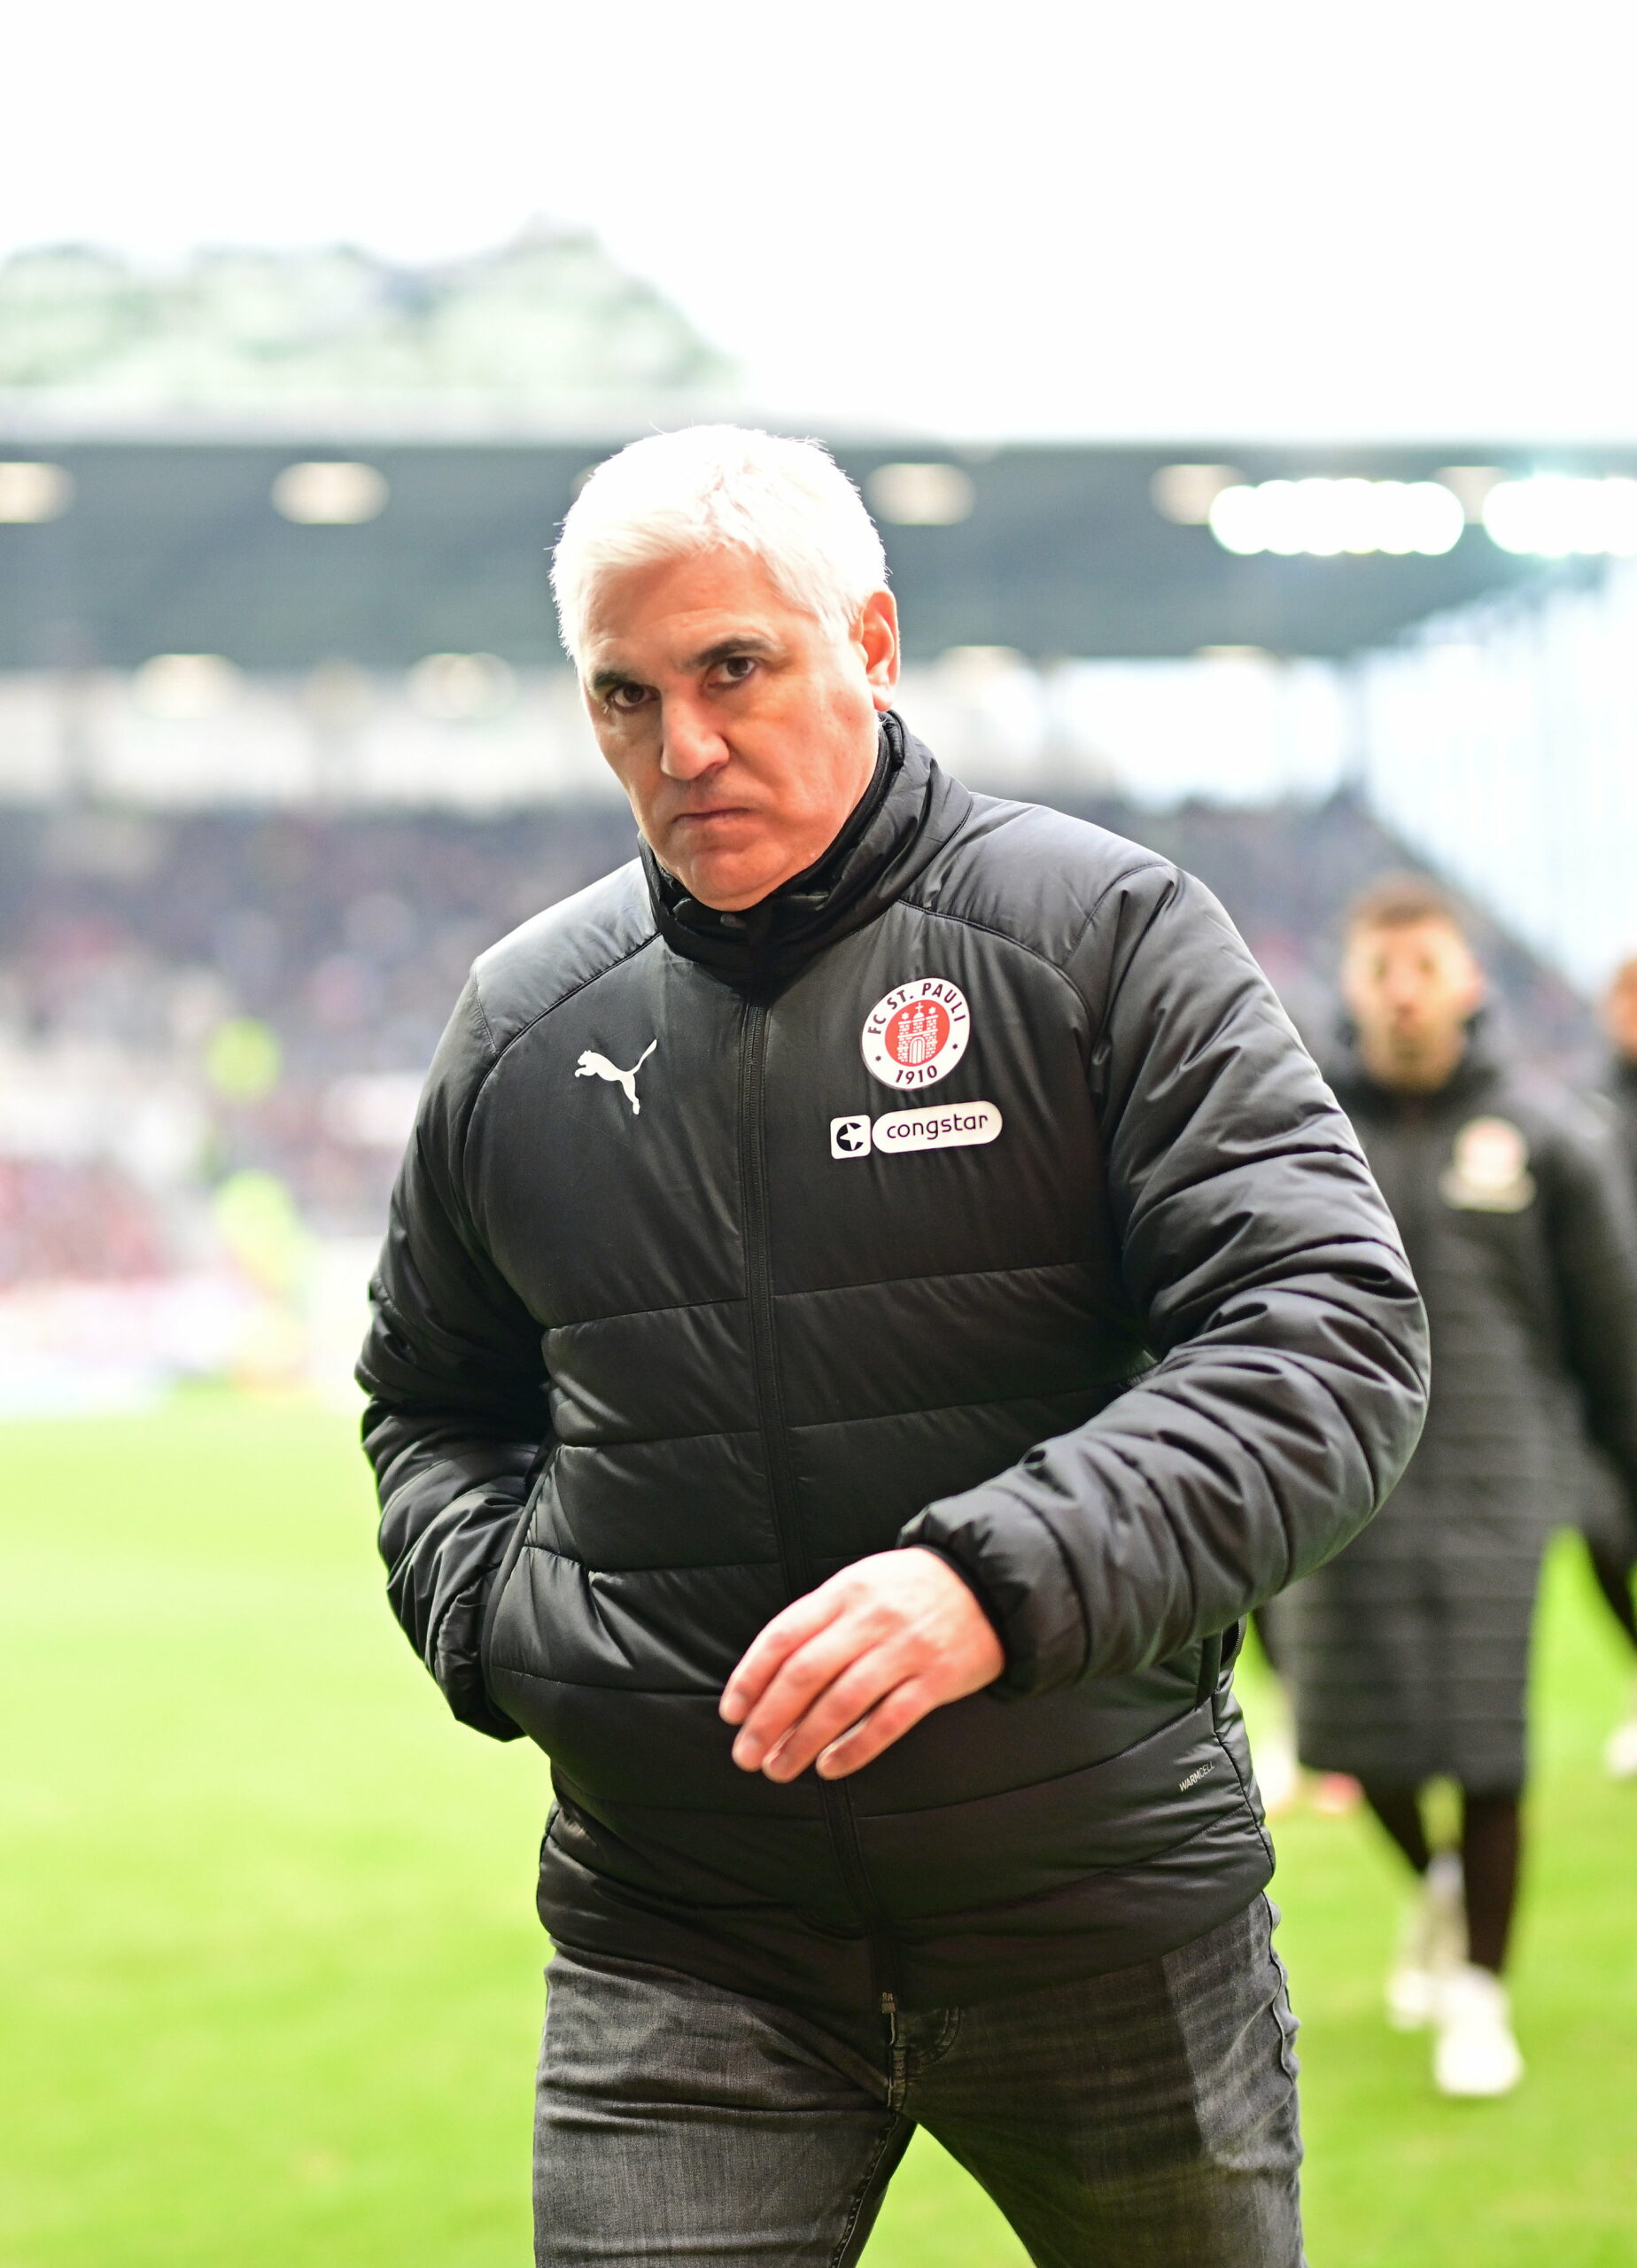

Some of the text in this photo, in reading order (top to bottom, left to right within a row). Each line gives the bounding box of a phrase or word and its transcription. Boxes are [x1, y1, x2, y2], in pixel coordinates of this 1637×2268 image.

[868, 983, 966, 1035] FC ST. PAULI
[896, 1065, 937, 1084] 1910
[887, 1114, 988, 1140] congstar
[1179, 1760, 1215, 1792] WARMCELL
